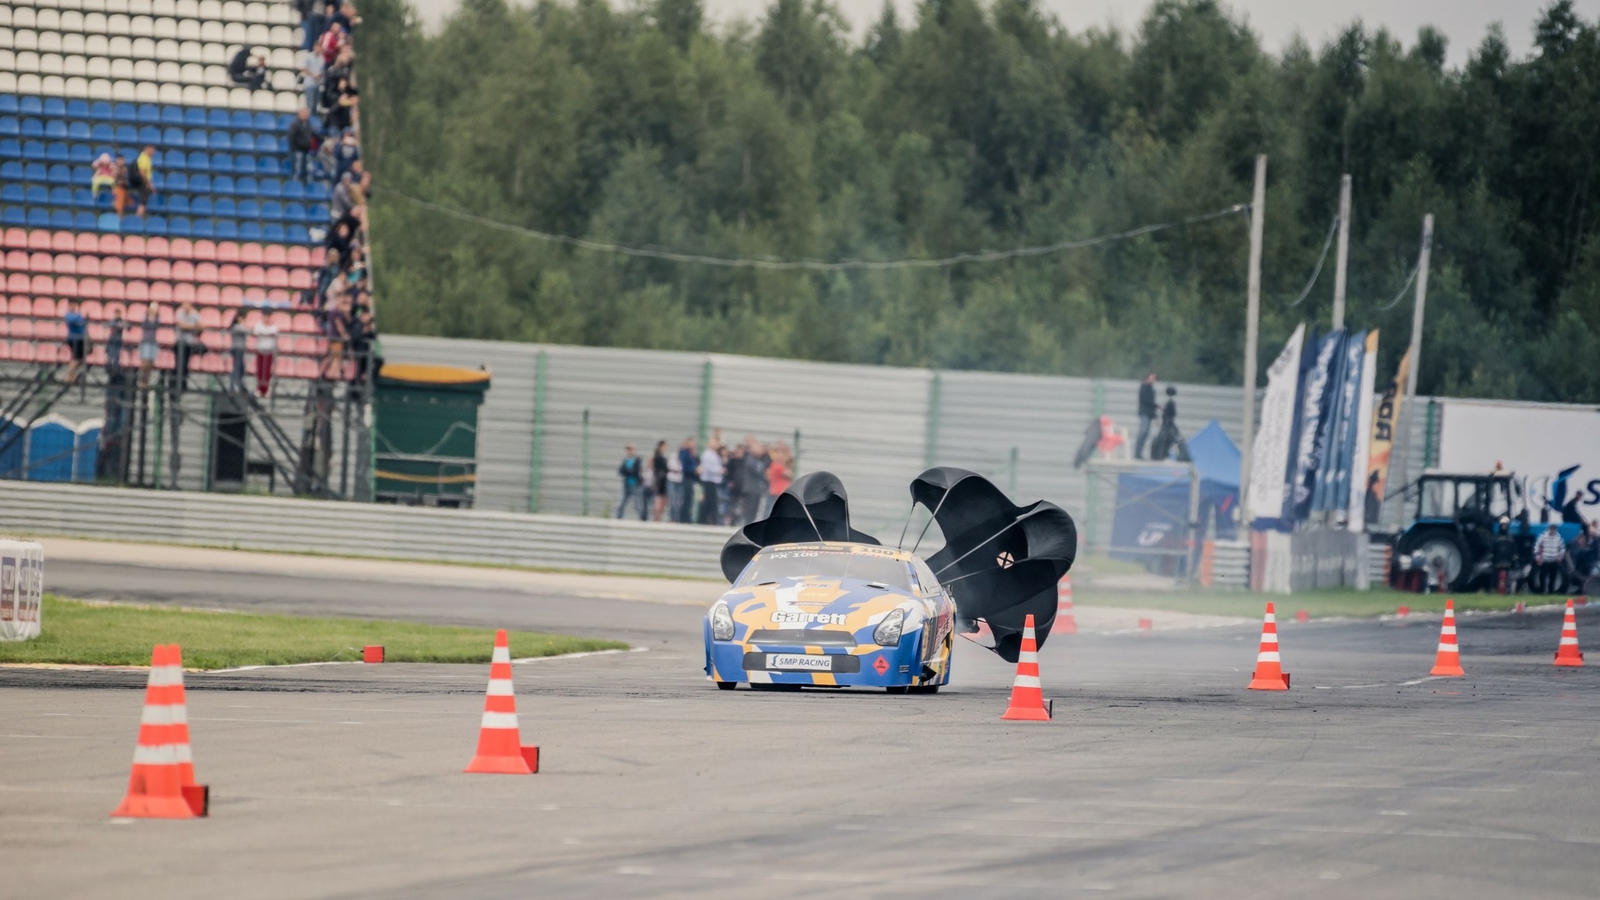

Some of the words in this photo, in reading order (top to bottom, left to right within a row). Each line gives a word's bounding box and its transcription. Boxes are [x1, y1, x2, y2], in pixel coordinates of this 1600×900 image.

[770, 552, 788, 560] PX
[770, 611, 847, 626] Garrett
[779, 658, 798, 666] SMP
[798, 658, 830, 667] RACING
